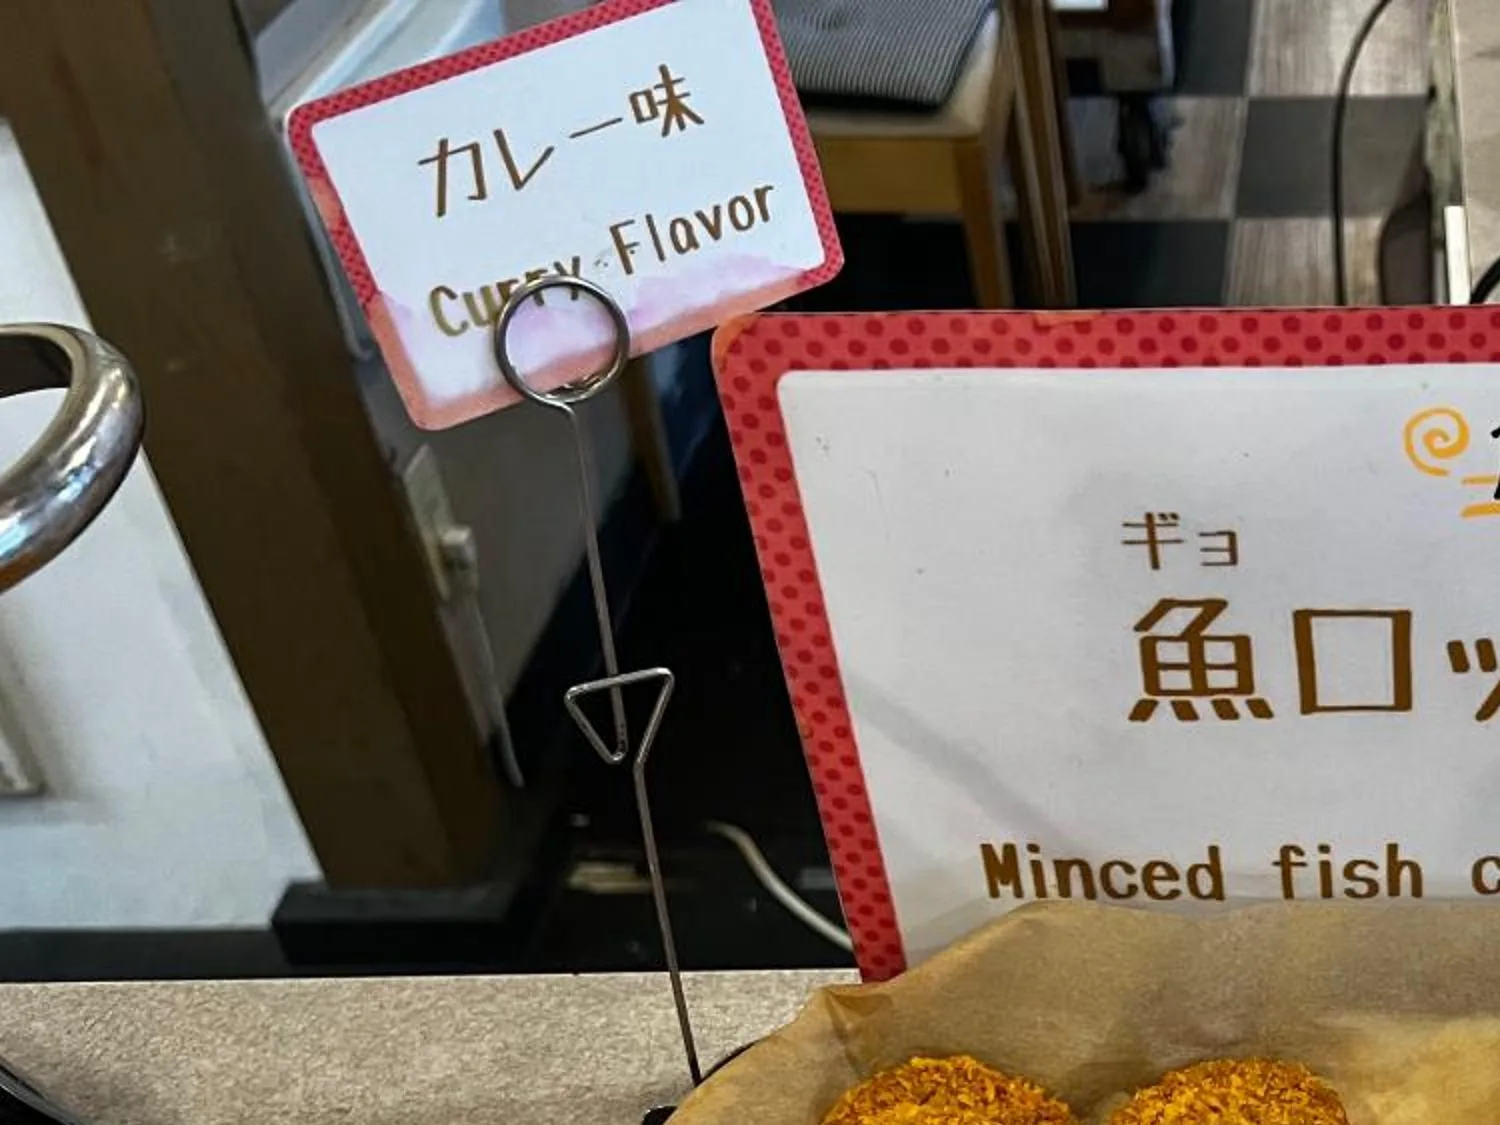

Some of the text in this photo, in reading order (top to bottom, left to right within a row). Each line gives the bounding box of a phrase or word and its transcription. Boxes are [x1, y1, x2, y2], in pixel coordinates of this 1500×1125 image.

[418, 64, 705, 217] カレー味
[609, 183, 775, 276] Flavor
[1121, 511, 1239, 570] ギョ
[980, 842, 1227, 902] Minced
[1271, 842, 1424, 900] fish
